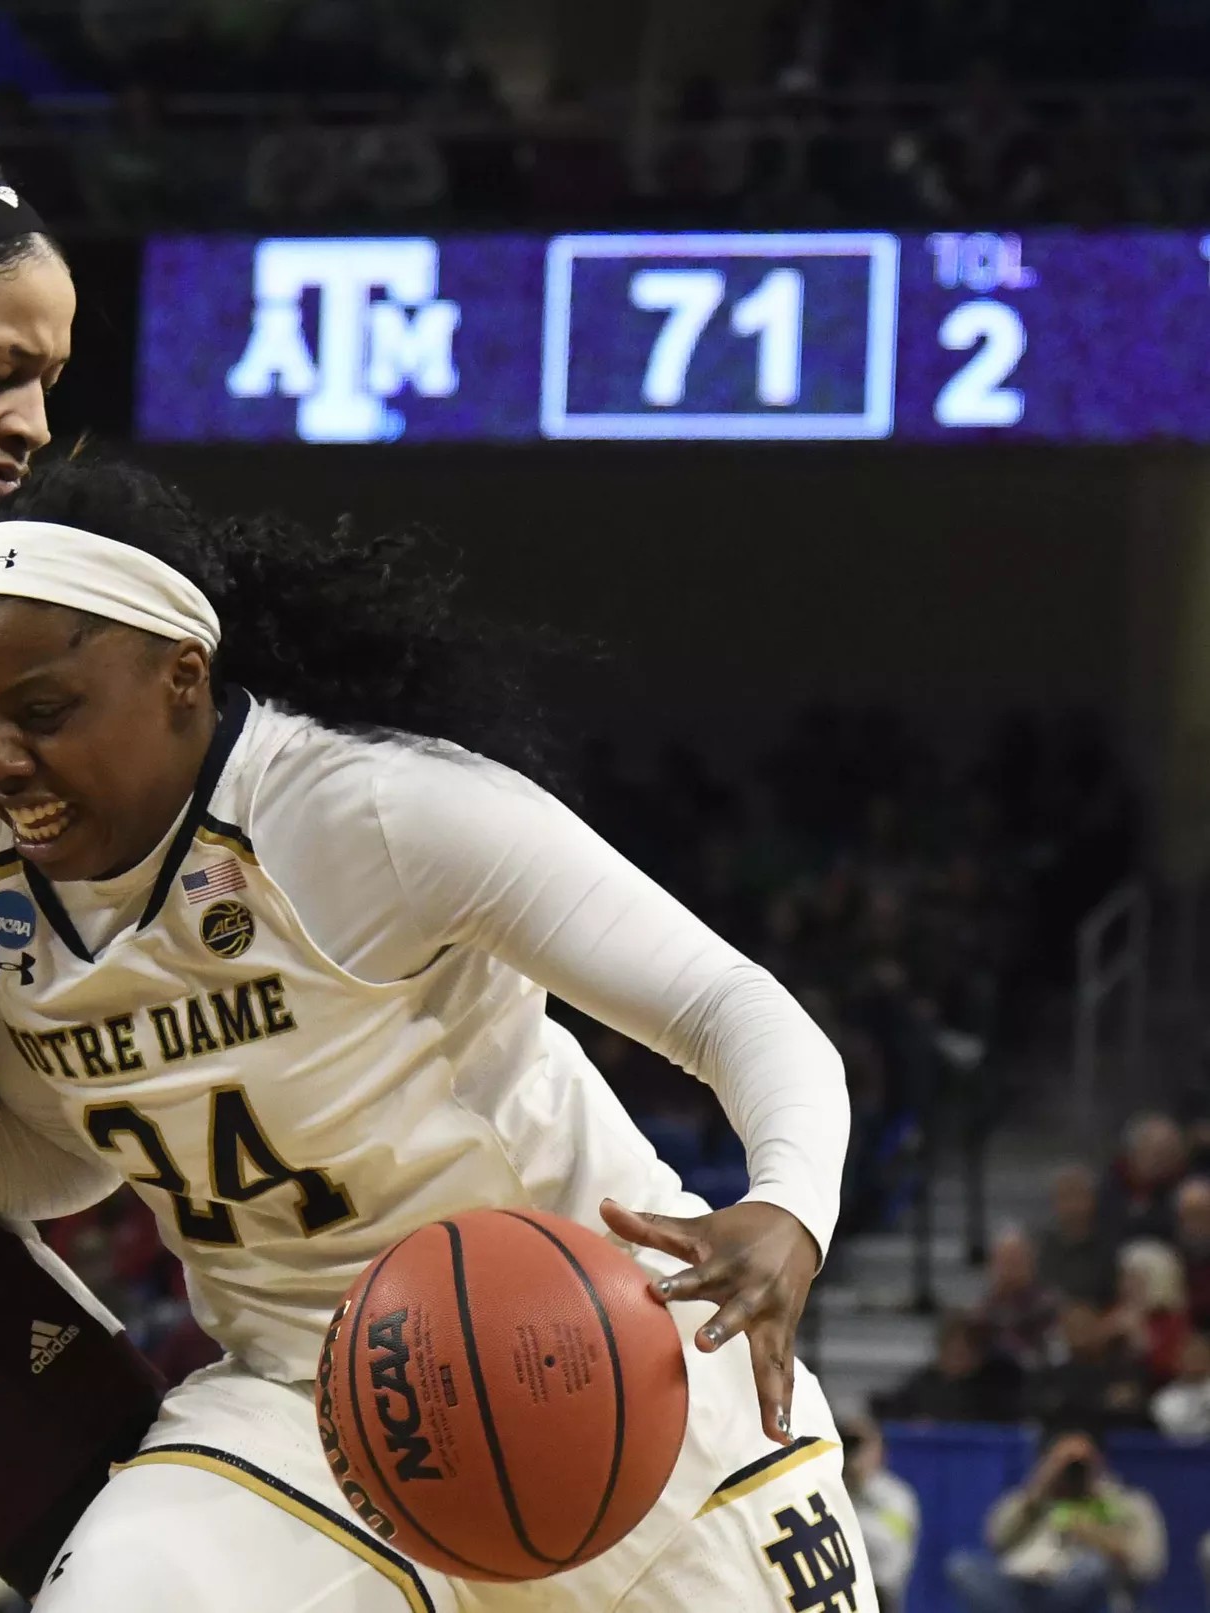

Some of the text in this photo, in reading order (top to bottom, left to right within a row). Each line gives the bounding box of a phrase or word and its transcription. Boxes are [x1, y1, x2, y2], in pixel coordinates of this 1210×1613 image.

[629, 268, 804, 406] 71
[935, 299, 1027, 427] 2
[148, 973, 298, 1064] DAME
[84, 1084, 359, 1248] 24
[31, 1324, 80, 1374] adidas
[368, 1308, 443, 1481] NCAA
